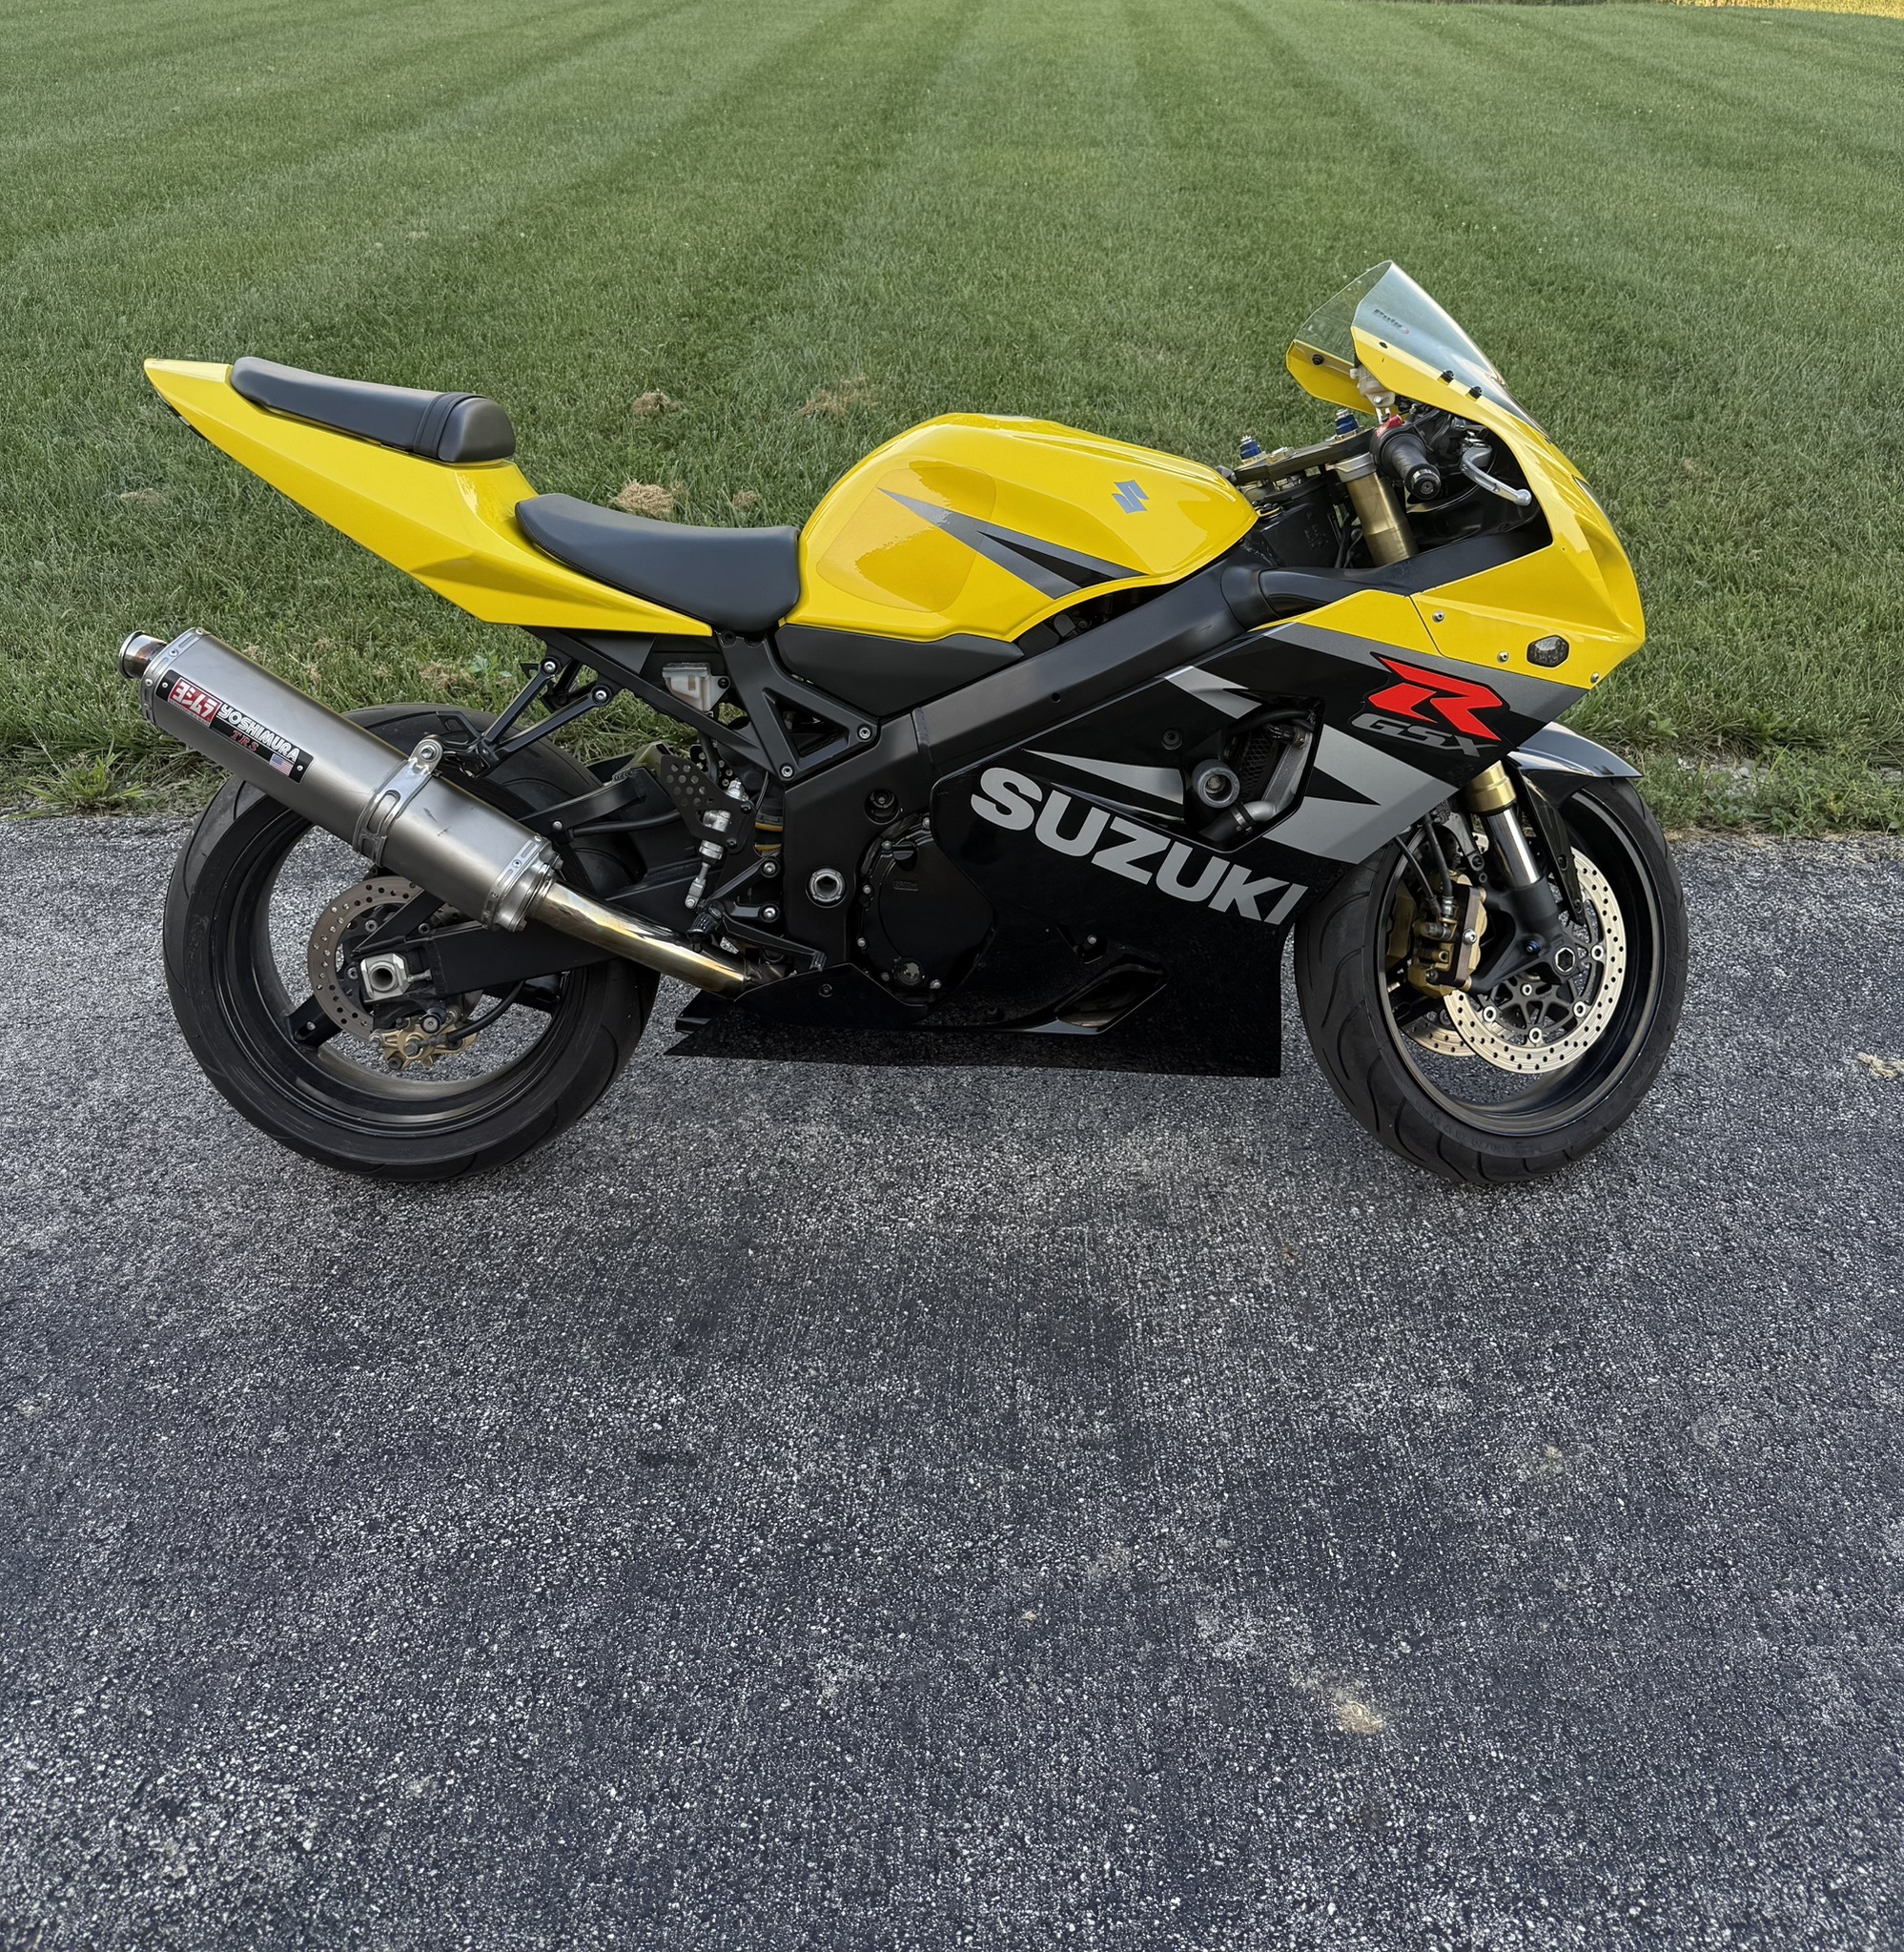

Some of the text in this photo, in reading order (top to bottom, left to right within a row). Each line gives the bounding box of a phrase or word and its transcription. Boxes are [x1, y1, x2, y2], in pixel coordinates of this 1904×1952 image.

[172, 681, 217, 720] ヨシムラ
[216, 703, 300, 762] YOSHIMURA
[231, 729, 259, 753] TRS
[1351, 712, 1499, 757] GSX
[971, 767, 1309, 925] SUZUKI
